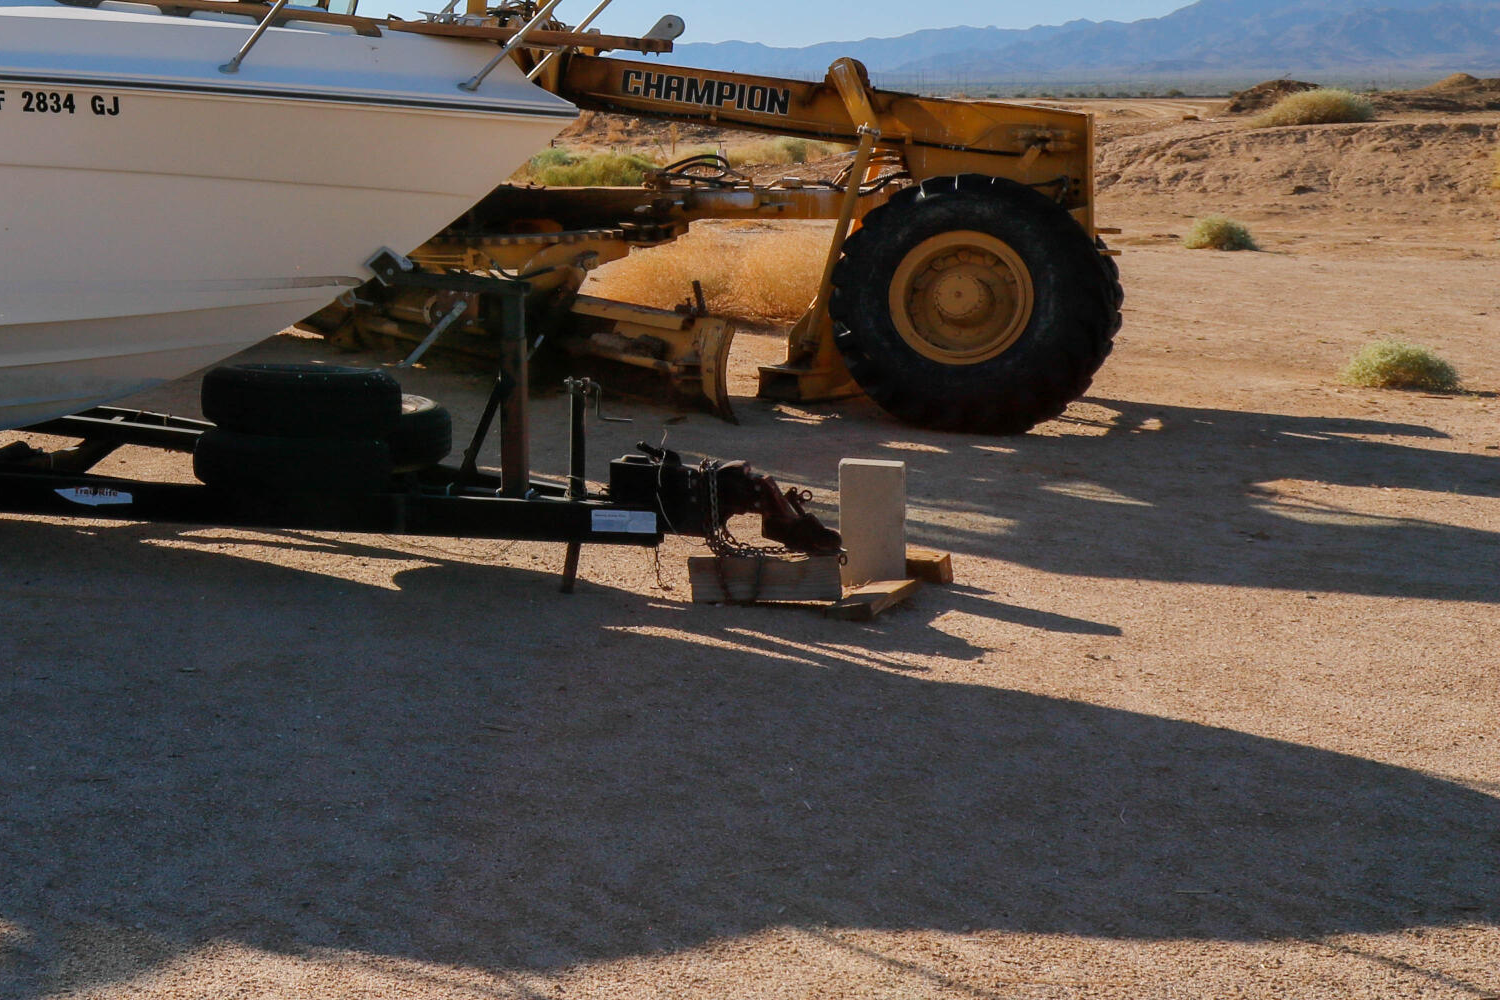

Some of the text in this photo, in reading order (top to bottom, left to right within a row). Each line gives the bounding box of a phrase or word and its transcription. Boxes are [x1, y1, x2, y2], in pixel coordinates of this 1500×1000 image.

[21, 91, 76, 114] 2834
[90, 95, 120, 116] GJ
[621, 69, 791, 116] CHAMPION
